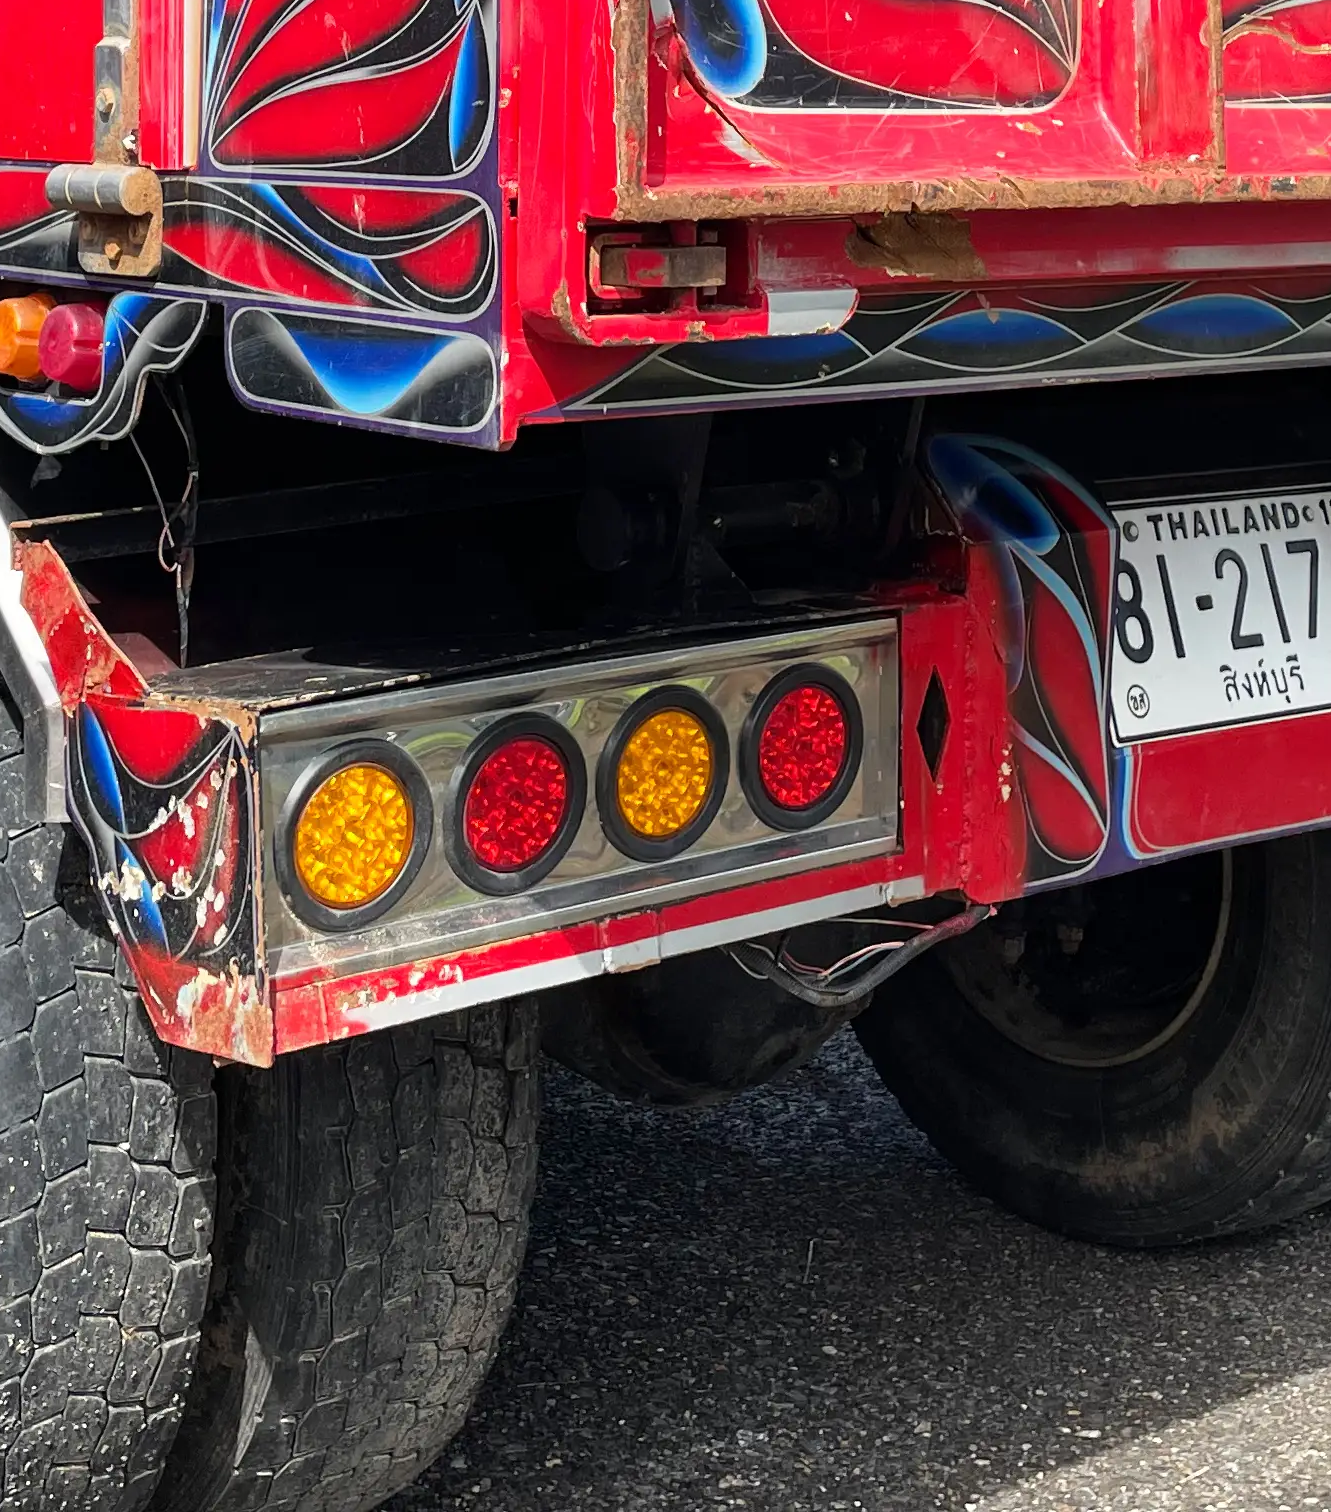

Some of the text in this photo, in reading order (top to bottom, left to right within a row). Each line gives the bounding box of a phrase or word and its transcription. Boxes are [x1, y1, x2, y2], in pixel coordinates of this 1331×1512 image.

[1146, 502, 1300, 541] THAILAND
[1219, 654, 1304, 704] สิงห์บุรี
